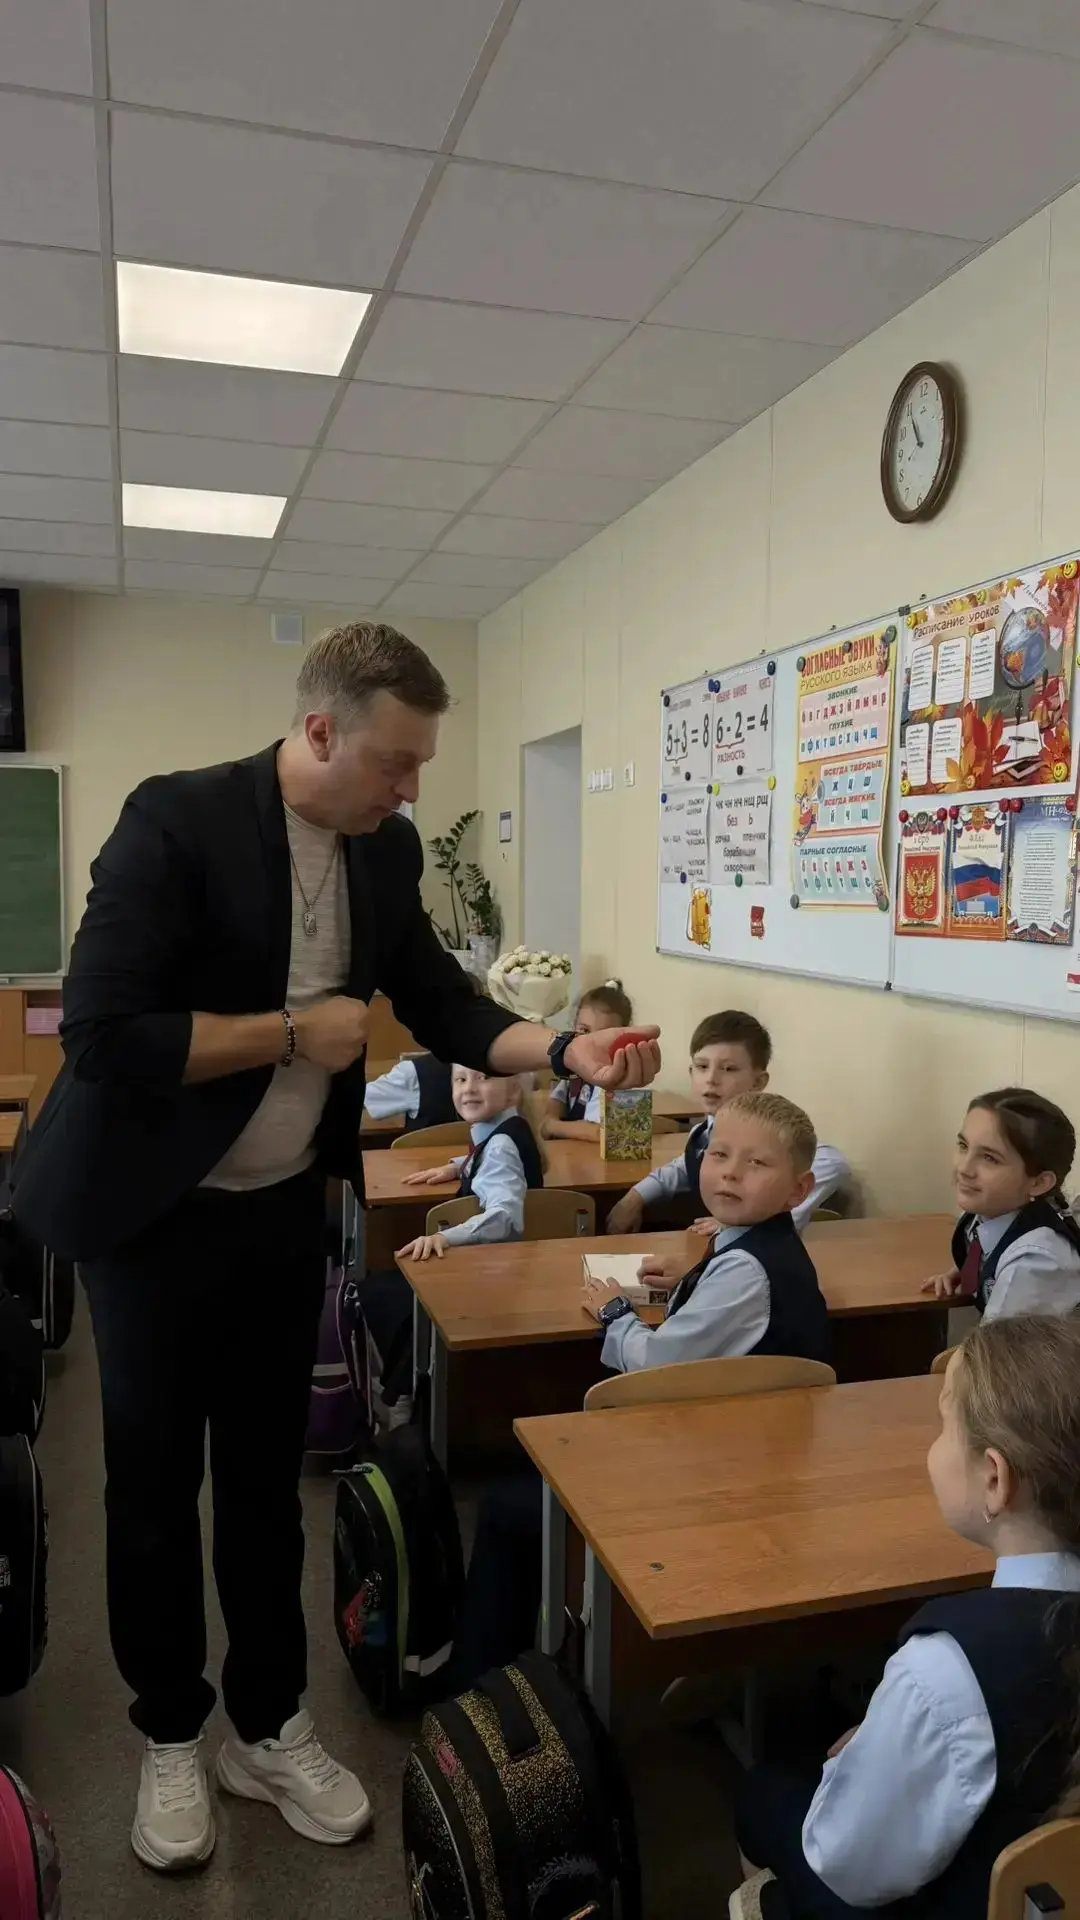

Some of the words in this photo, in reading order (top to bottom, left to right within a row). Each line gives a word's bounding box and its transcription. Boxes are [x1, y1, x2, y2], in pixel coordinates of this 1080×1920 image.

[913, 615, 965, 640] Расписание
[968, 604, 1000, 623] уроков
[800, 669, 841, 691] РУССКОГО
[843, 660, 873, 677] ЯЗЫКА
[827, 685, 858, 700] ЗВОНКИЕ
[828, 718, 854, 731] ГЛУХИЕ
[824, 766, 848, 776] ВСЕГДА
[824, 797, 847, 807] ВСЕГДА
[848, 792, 876, 803] МЯГКИЕ
[726, 814, 738, 827] без
[800, 848, 826, 856] ПАРНЫЕ
[826, 844, 867, 854] СОГЛАСНЫЕ
